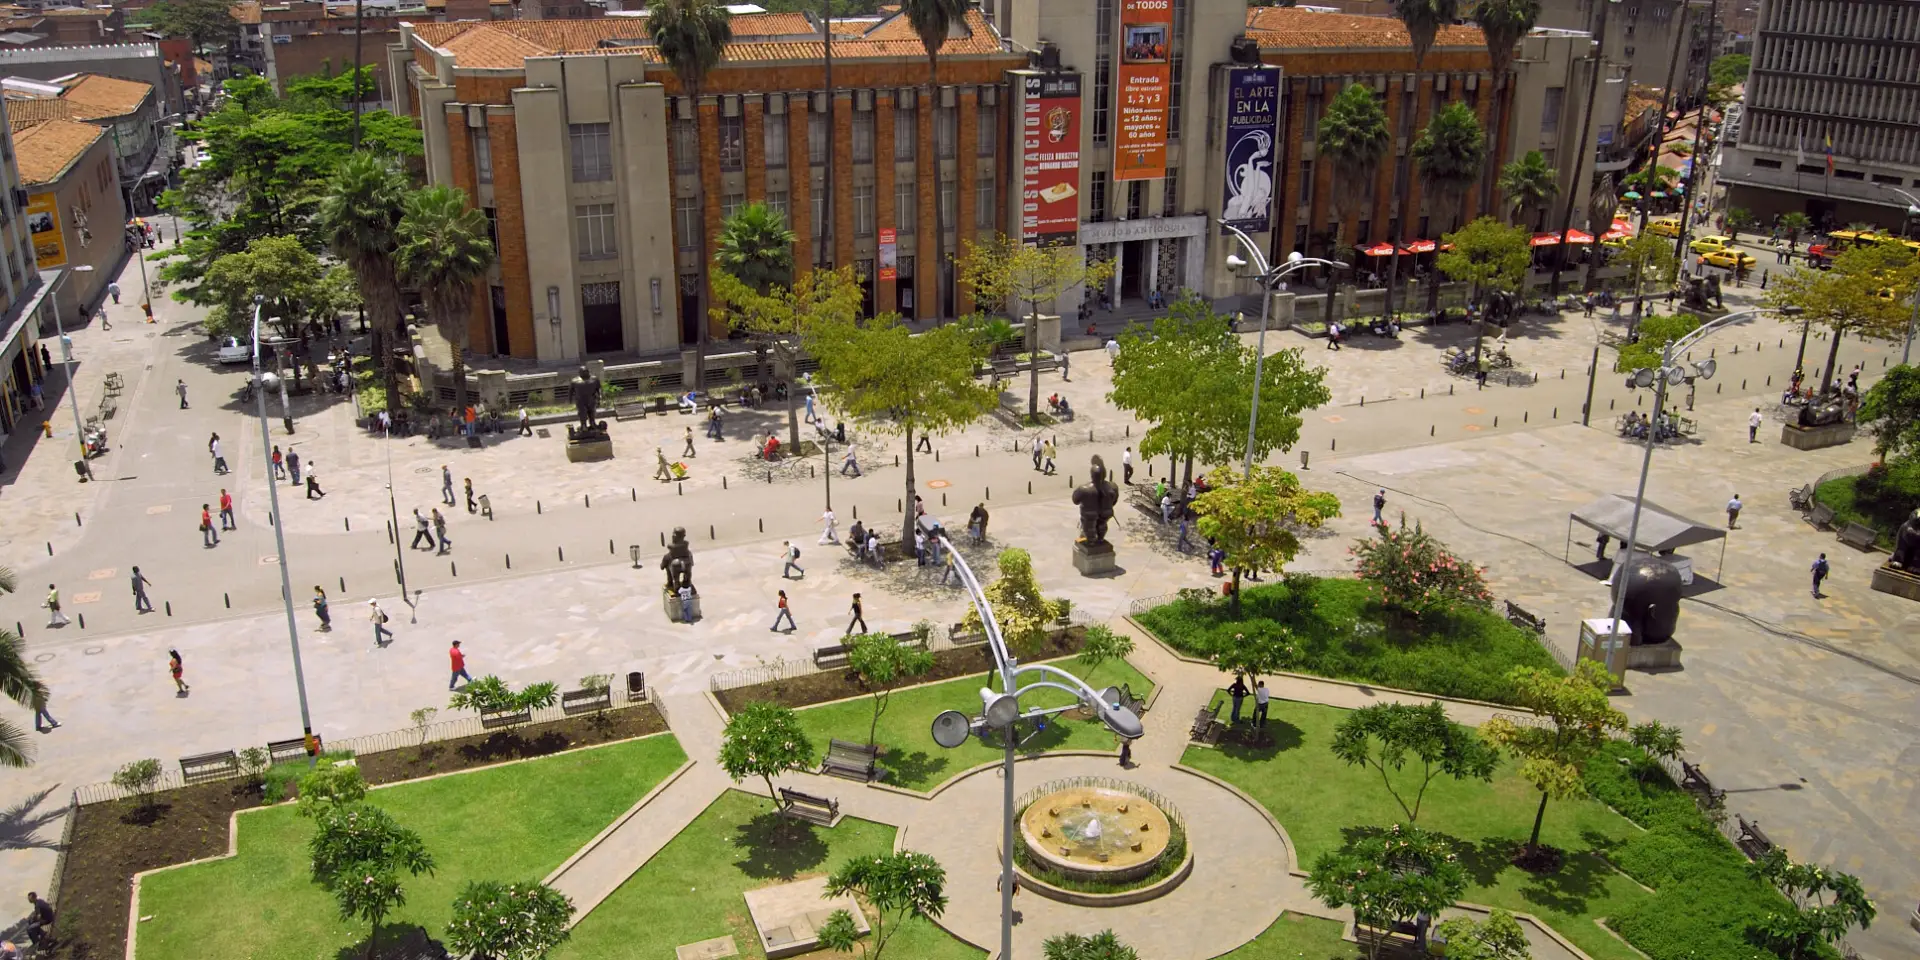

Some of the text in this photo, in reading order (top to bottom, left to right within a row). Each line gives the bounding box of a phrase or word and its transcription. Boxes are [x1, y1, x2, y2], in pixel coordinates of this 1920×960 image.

[1136, 1, 1168, 9] TODOS
[1130, 76, 1159, 84] Entrada
[1234, 86, 1274, 98] EL ARTE
[1128, 94, 1160, 105] 1, 2 y 3
[1237, 100, 1269, 113] EN LA
[1232, 115, 1273, 125] PUBLICIDAD
